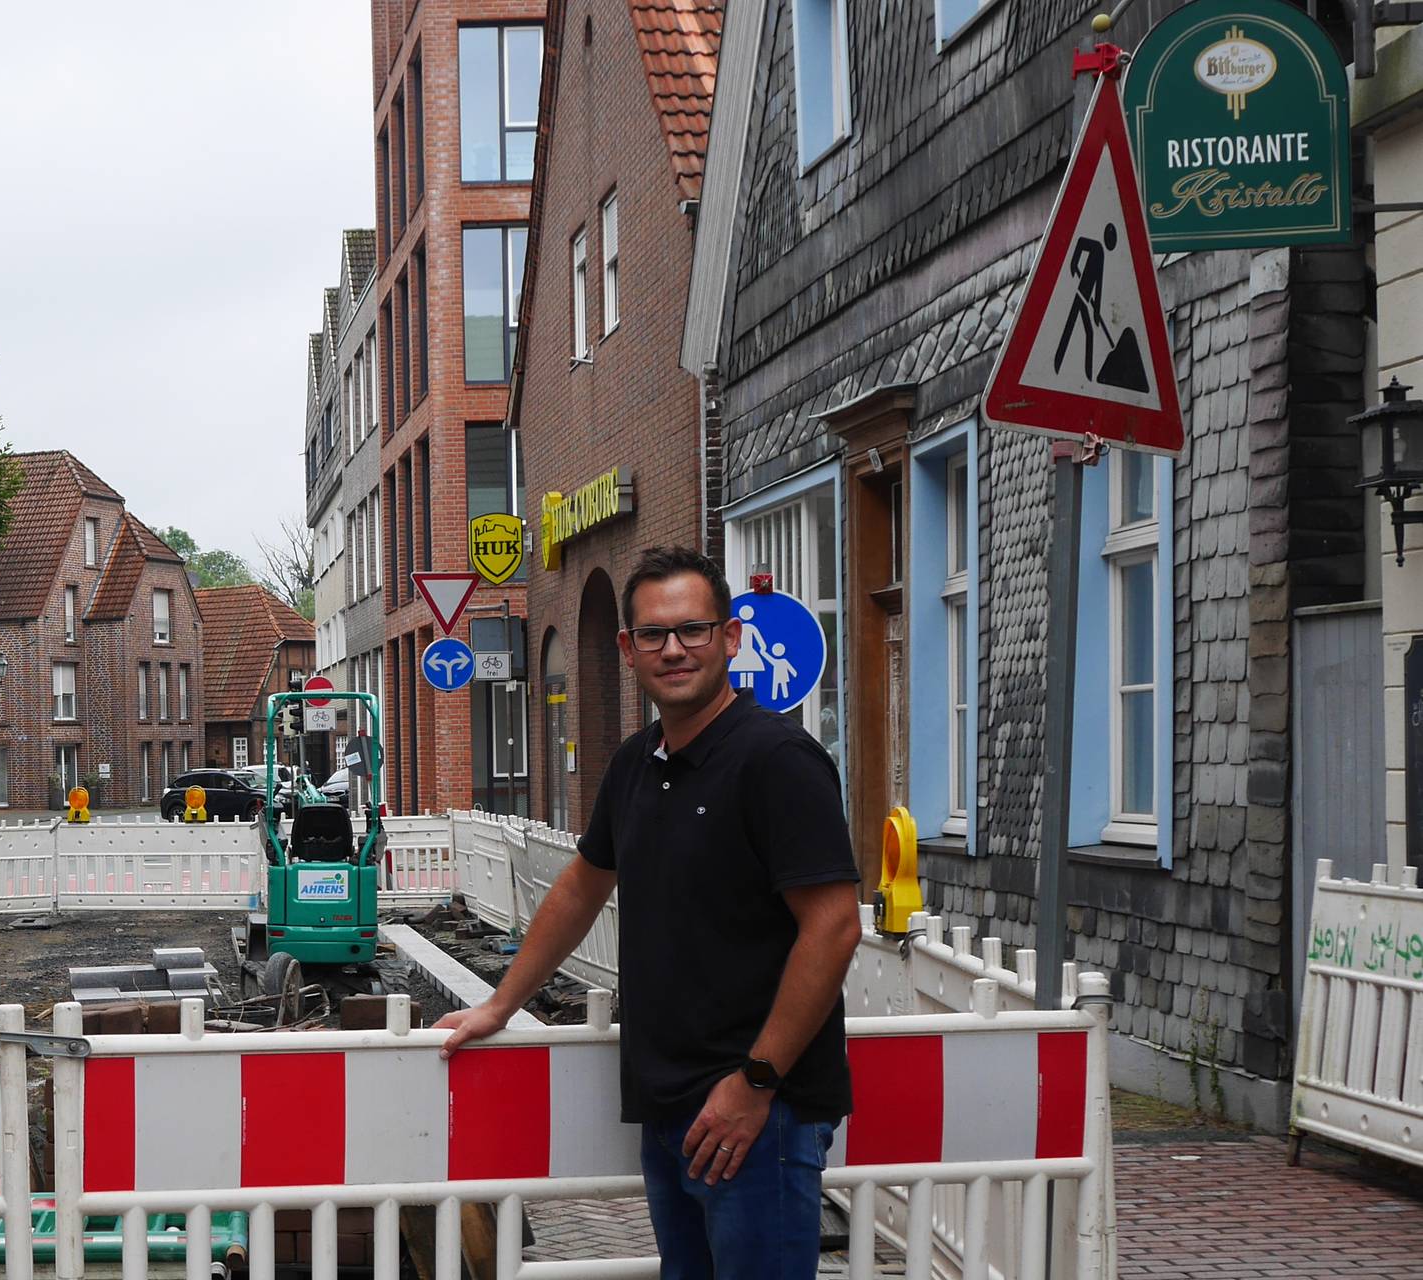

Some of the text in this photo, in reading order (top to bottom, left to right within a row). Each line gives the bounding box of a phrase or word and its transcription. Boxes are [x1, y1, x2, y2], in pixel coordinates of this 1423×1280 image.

[1206, 54, 1266, 77] Bitburger
[1167, 132, 1309, 168] RISTORANTE
[1150, 168, 1329, 219] Kristallo
[551, 465, 619, 545] HUK-COBURG
[473, 540, 521, 556] HUK
[486, 669, 499, 678] frei
[301, 884, 345, 895] AHRENS
